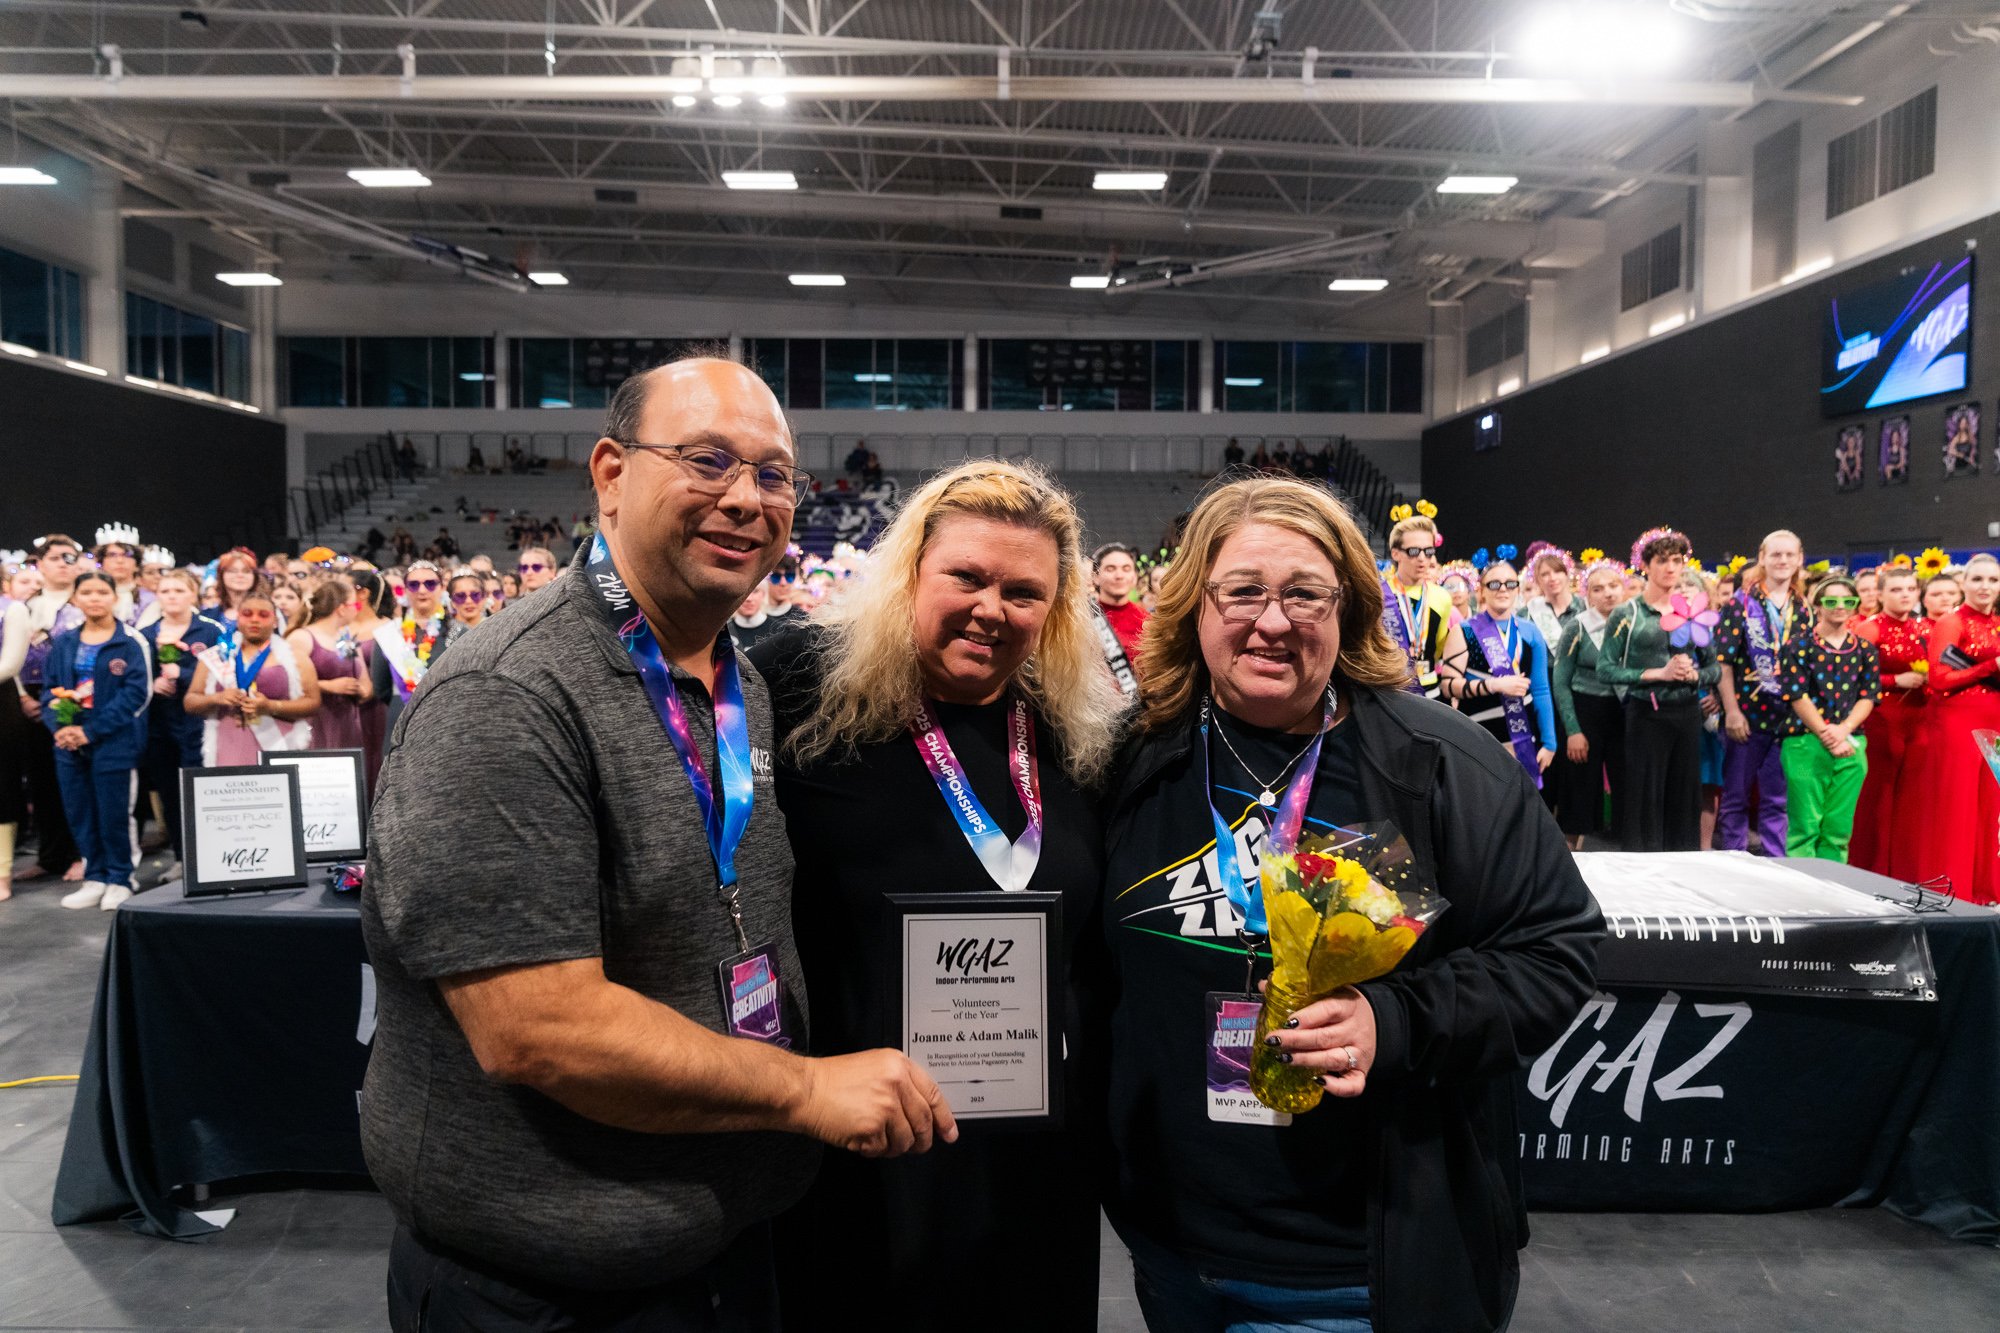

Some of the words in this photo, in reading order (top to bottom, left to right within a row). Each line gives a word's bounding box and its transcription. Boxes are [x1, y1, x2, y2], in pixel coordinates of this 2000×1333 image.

[596, 571, 631, 612] WGAZ
[1016, 699, 1034, 799] CHAMPIONSHIPS
[204, 786, 281, 796] CHAMPIONSHIPS
[226, 780, 258, 788] GUARD
[924, 732, 987, 834] CHAMPIONSHIPS
[205, 814, 240, 823] FIRST
[242, 811, 282, 822] PLACE
[222, 848, 269, 869] WGAZ
[1173, 894, 1257, 937] ZA
[1612, 915, 1786, 945] CHAMPION
[936, 937, 1015, 976] WGAZ
[1761, 959, 1789, 970] PROUD
[936, 977, 959, 985] Indoor
[960, 976, 999, 985] Performing
[1001, 975, 1016, 984] Arts
[733, 978, 777, 1024] CREATIVITY
[952, 998, 1000, 1008] Volunteers
[953, 1011, 962, 1020] of
[965, 1011, 977, 1020] the
[979, 1010, 998, 1019] Year
[912, 1031, 952, 1043] Joanne
[956, 1031, 965, 1042] &
[969, 1030, 1002, 1041] Adam
[1006, 1028, 1039, 1040] Malik
[1213, 1029, 1255, 1047] CREATI
[934, 1052, 969, 1061] Recognition
[970, 1051, 976, 1059] of
[977, 1052, 990, 1060] your
[991, 1050, 1025, 1059] Outstanding
[981, 1058, 1008, 1067] Pageantry
[1527, 990, 1753, 1129] GAZ
[1215, 1097, 1237, 1107] MVP
[1660, 1137, 1736, 1165] ARTS
